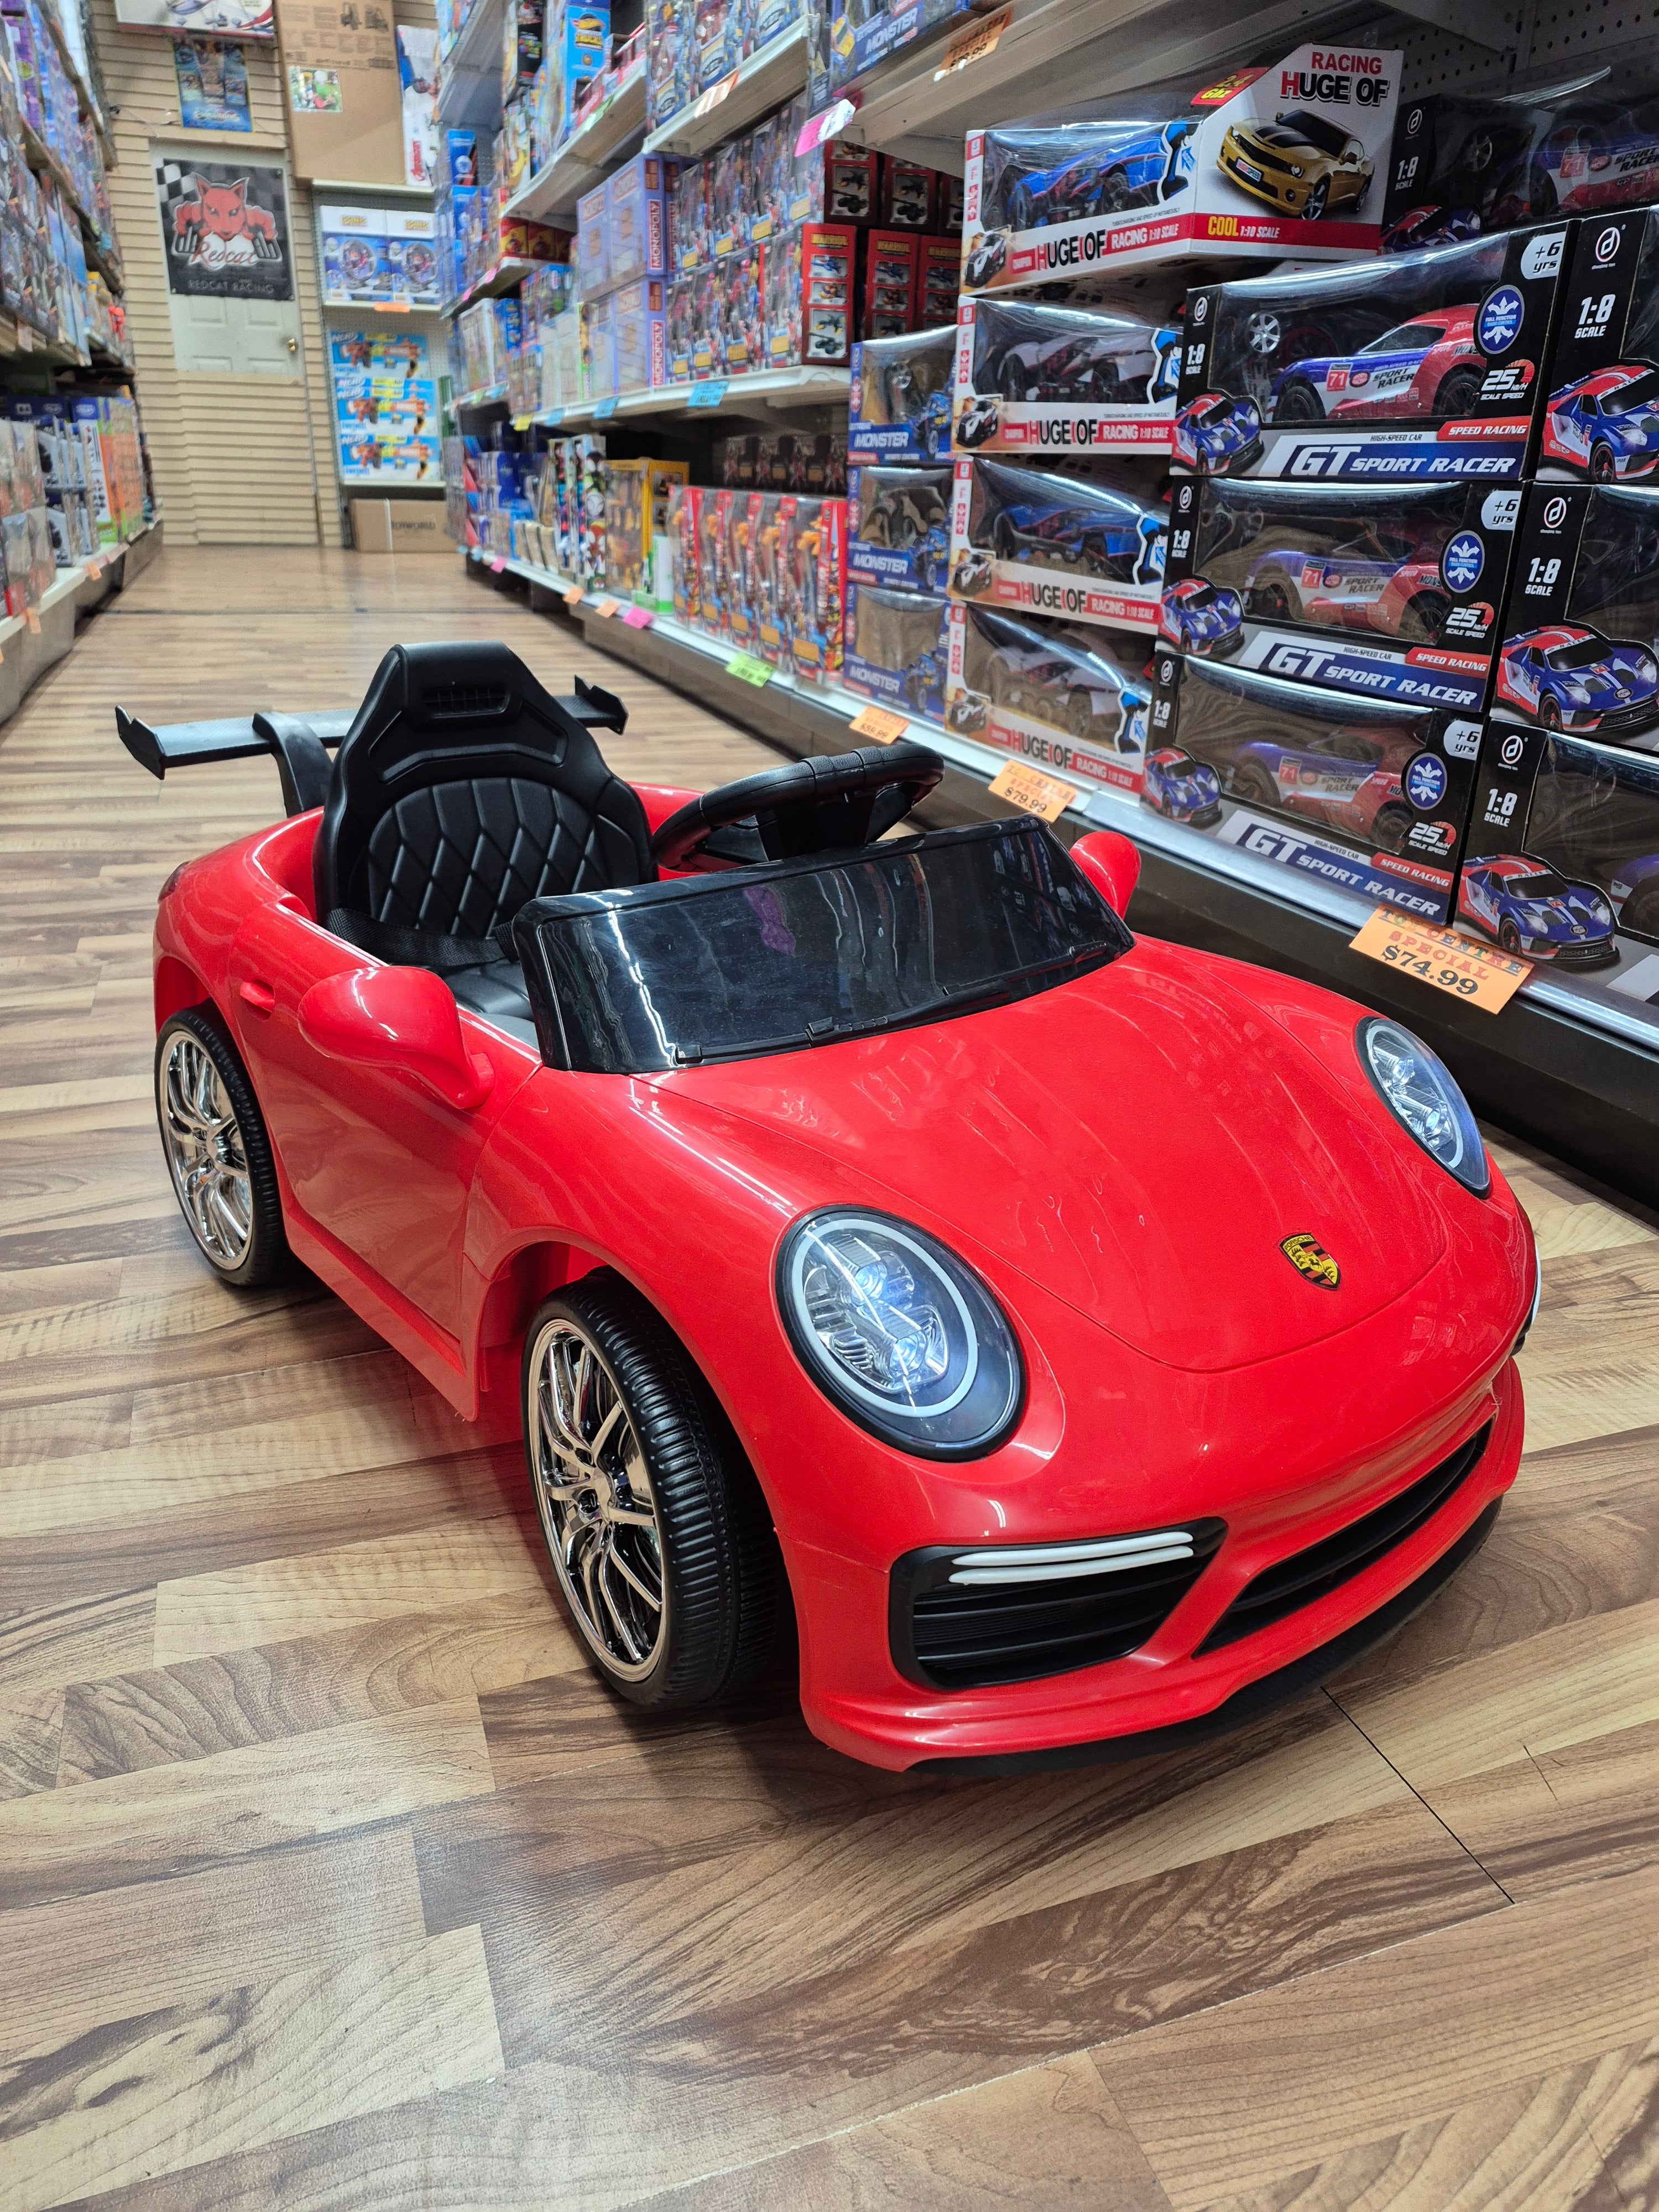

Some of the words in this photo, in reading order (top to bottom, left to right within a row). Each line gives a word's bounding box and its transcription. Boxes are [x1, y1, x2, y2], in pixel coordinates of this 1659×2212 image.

[865, 8, 918, 54] MONSTER
[1311, 52, 1382, 75] RACING
[1281, 71, 1350, 103] HUGE
[1356, 77, 1390, 107] OF
[1614, 149, 1657, 164] SPORT
[1397, 156, 1419, 180] 1:8
[651, 201, 661, 269] MONOPOLY
[1208, 216, 1239, 237] COOL
[1240, 226, 1256, 238] 1:10
[1256, 226, 1280, 239] SCALE
[1036, 239, 1079, 271] HUGE
[1083, 229, 1107, 262] OF
[1112, 227, 1147, 249] RACING
[1161, 222, 1180, 238] SCALE
[1536, 241, 1563, 258] +6
[1533, 260, 1558, 273] yrs
[188, 279, 229, 290] REDCAT
[232, 281, 275, 294] RACING
[1578, 294, 1616, 325] 1:8
[1574, 325, 1606, 338] SCALE
[654, 321, 664, 385] MONOPOLY
[1187, 343, 1206, 365] 1:8
[1329, 372, 1345, 387] 71
[1373, 368, 1408, 382] SPORT
[1377, 374, 1415, 389] RACER
[1481, 369, 1520, 391] 25
[854, 432, 909, 447] MONSTER
[1028, 419, 1072, 445] HUGE
[1077, 419, 1098, 445] OF
[1103, 425, 1138, 439] RACING
[1449, 426, 1482, 435] SPEED
[1483, 425, 1528, 434] RACING
[1291, 446, 1362, 476] GT
[1350, 457, 1427, 472] SPORT
[1428, 457, 1516, 473] RACER
[1495, 499, 1519, 512] +6
[1492, 515, 1514, 524] yrs
[1173, 530, 1191, 549] 1:8
[853, 554, 908, 574] MONSTER
[1528, 557, 1562, 584] 1:8
[1303, 571, 1318, 584] 71
[1345, 577, 1380, 586] SPORT
[1349, 583, 1384, 594] RACER
[1525, 584, 1553, 596] SCALE
[1021, 581, 1062, 608] HUGE
[1066, 588, 1087, 613] OF
[1091, 598, 1125, 615] RACING
[1137, 607, 1154, 619] SCALE
[1446, 607, 1481, 628] 25
[1344, 646, 1378, 658] HIGH-SPEED
[1416, 653, 1447, 665] SPEED
[1447, 658, 1488, 672] RACING
[849, 665, 900, 693] MONSTER
[1268, 646, 1336, 680] GT
[1324, 666, 1396, 688] SPORT
[1396, 679, 1478, 705] RACER
[1154, 698, 1171, 720] 1:8
[1457, 731, 1480, 743] +6
[1012, 729, 1049, 763] HUGE
[1053, 744, 1072, 769] OF
[1077, 756, 1107, 779] RACING
[1454, 744, 1476, 753] yrs
[1282, 768, 1295, 780] 71
[1422, 777, 1440, 786] FUNCTION
[1004, 787, 1047, 813] $79.99
[1487, 789, 1517, 816] 1:8
[1484, 812, 1510, 827] SCALE
[1408, 822, 1444, 844] 25
[1314, 839, 1347, 855] HIGH-SPEED
[1347, 851, 1359, 860] CAR
[1245, 828, 1307, 863] GT
[1296, 854, 1363, 885] SPORT
[1364, 881, 1441, 916] RACER
[1380, 858, 1411, 874] SPEED
[1411, 869, 1450, 887] RACING
[1389, 931, 1489, 980] SPECIAL
[1427, 928, 1525, 974] CENTRE
[1381, 945, 1479, 995] $74.99
[1285, 1235, 1312, 1251] PORSCHE
